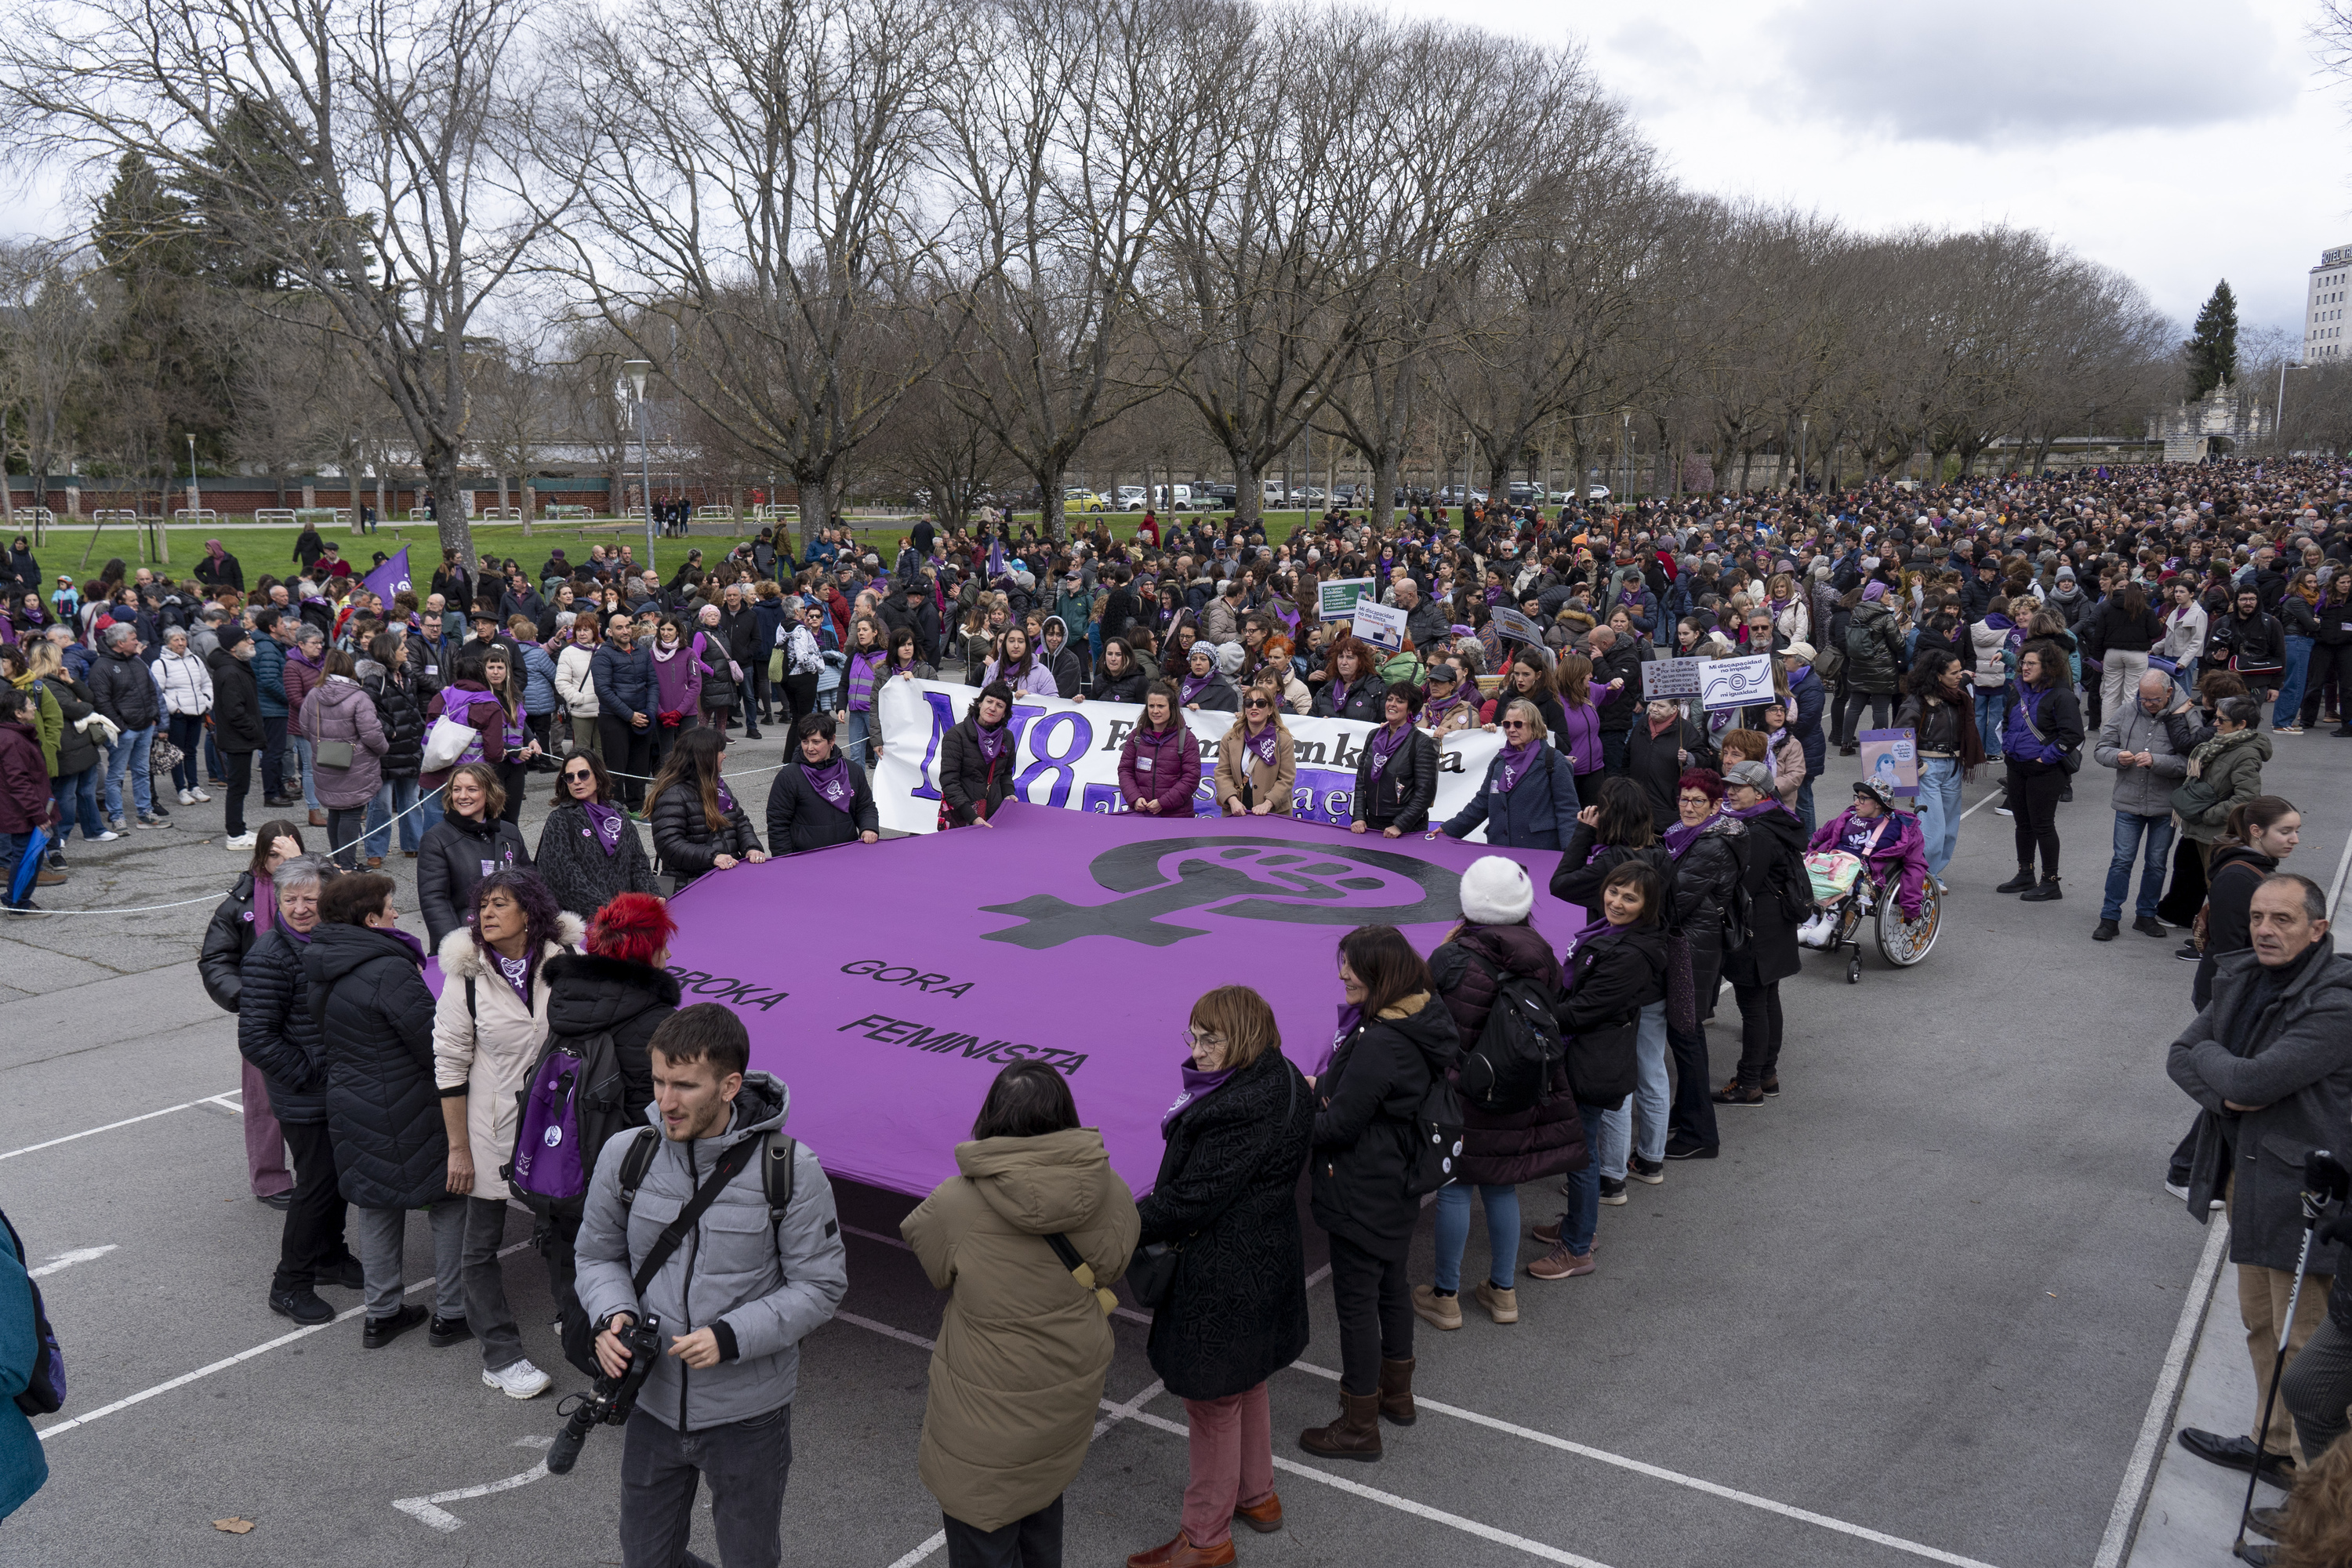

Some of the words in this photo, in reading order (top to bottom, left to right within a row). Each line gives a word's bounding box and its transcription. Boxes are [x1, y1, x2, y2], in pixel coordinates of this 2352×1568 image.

[2321, 249, 2341, 263] HOTEL
[1365, 608, 1395, 619] discapacidad
[1717, 659, 1762, 669] discapacidad
[1729, 688, 1758, 697] igualdad
[840, 960, 975, 999] GORA
[836, 1014, 1089, 1076] FEMINISTA
